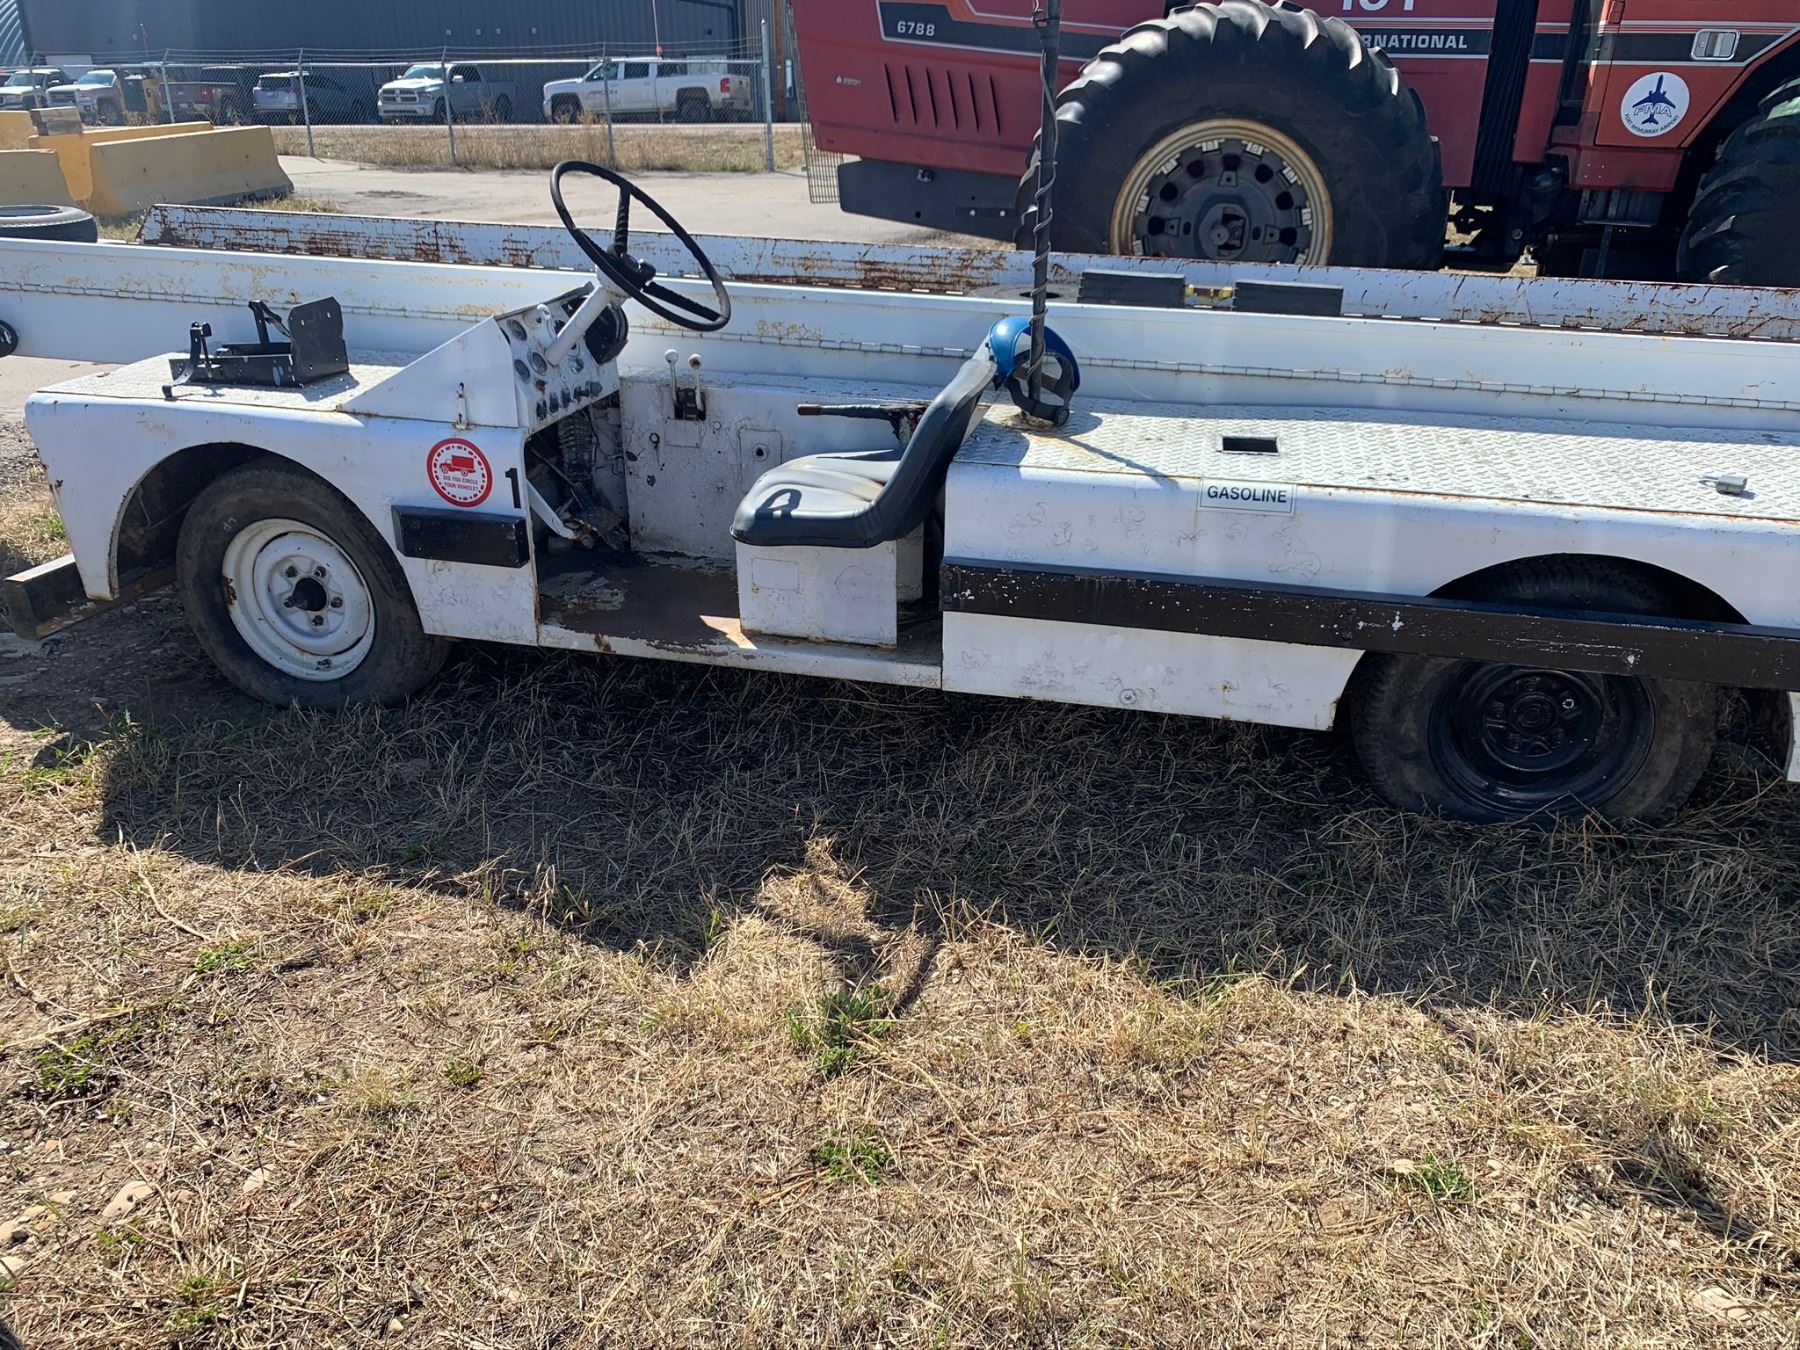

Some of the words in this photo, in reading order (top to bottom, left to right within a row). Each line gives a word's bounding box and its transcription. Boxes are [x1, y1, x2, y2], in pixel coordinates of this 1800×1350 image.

[897, 21, 935, 36] 6788
[1361, 34, 1468, 49] RNATIONAL
[1633, 104, 1672, 117] FMA
[1660, 115, 1679, 131] AIRPORT
[1207, 485, 1287, 503] GASOLINE
